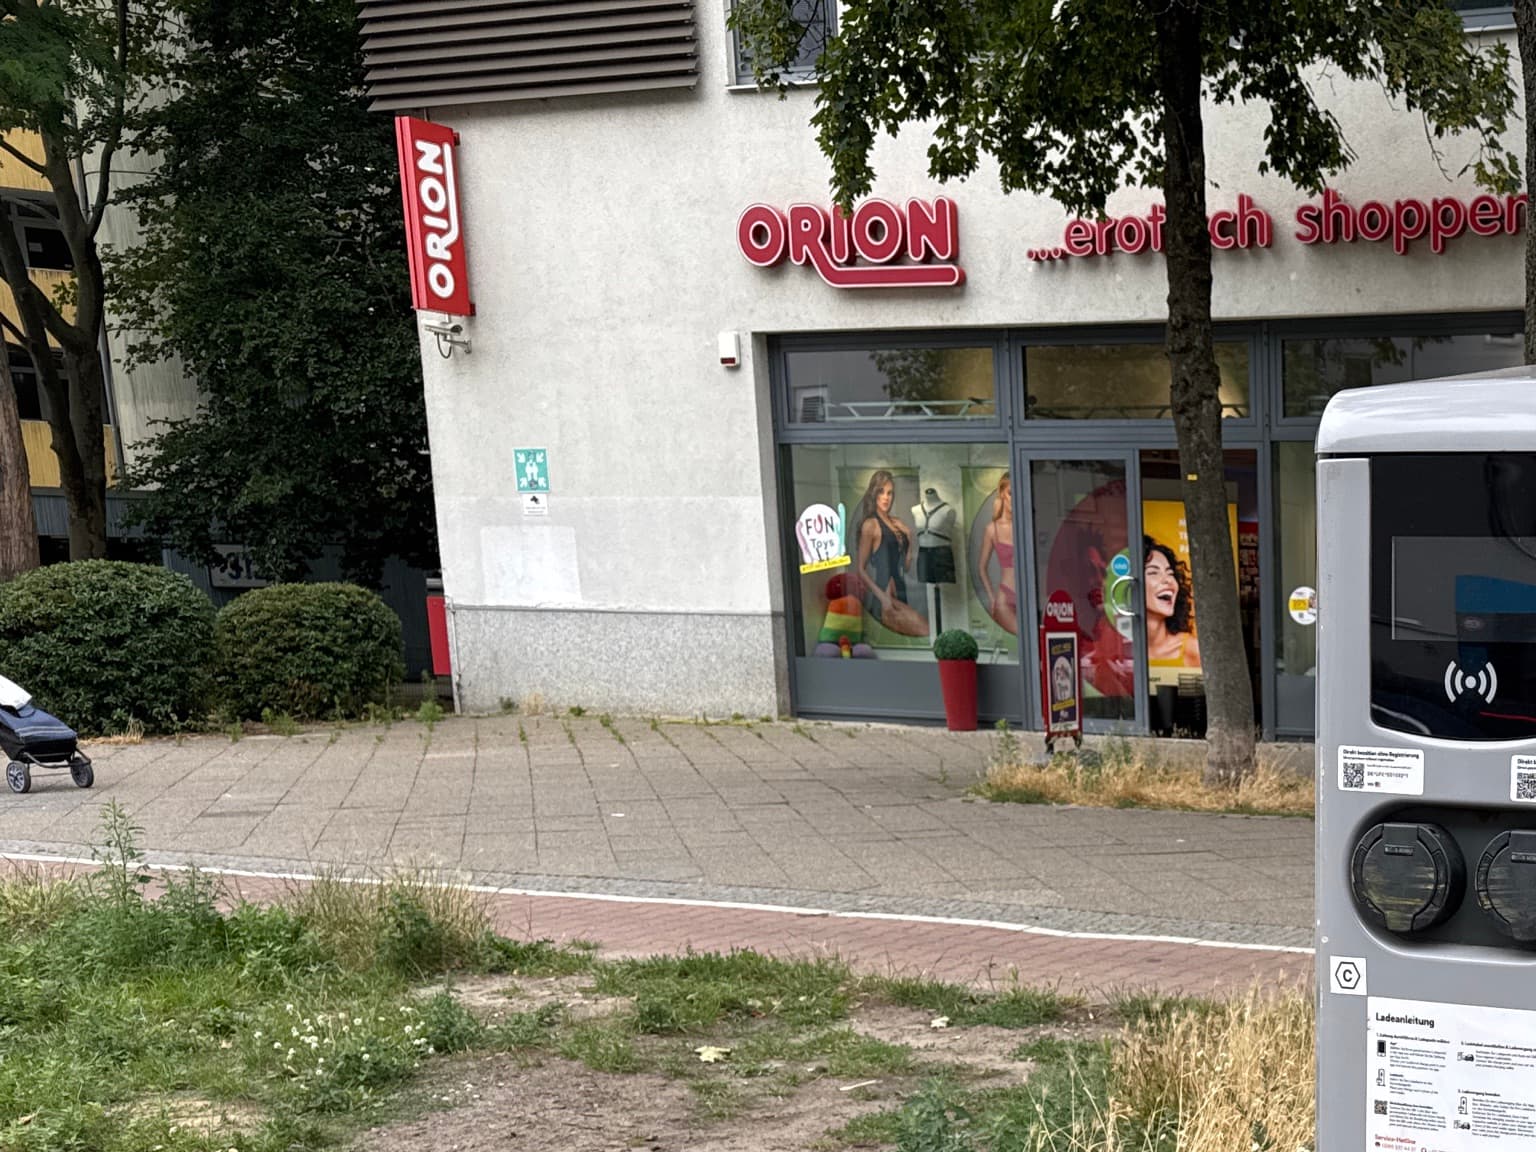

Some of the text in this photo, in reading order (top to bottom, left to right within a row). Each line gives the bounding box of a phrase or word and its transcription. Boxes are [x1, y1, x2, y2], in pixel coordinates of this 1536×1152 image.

[415, 139, 459, 298] ORION
[736, 195, 962, 289] ORION
[805, 514, 835, 536] FUN
[810, 539, 835, 550] Toys
[1046, 602, 1075, 622] ORION
[1517, 758, 1533, 766] Direkt
[1342, 969, 1353, 982] C
[1376, 1012, 1435, 1028] Ladeanleitung
